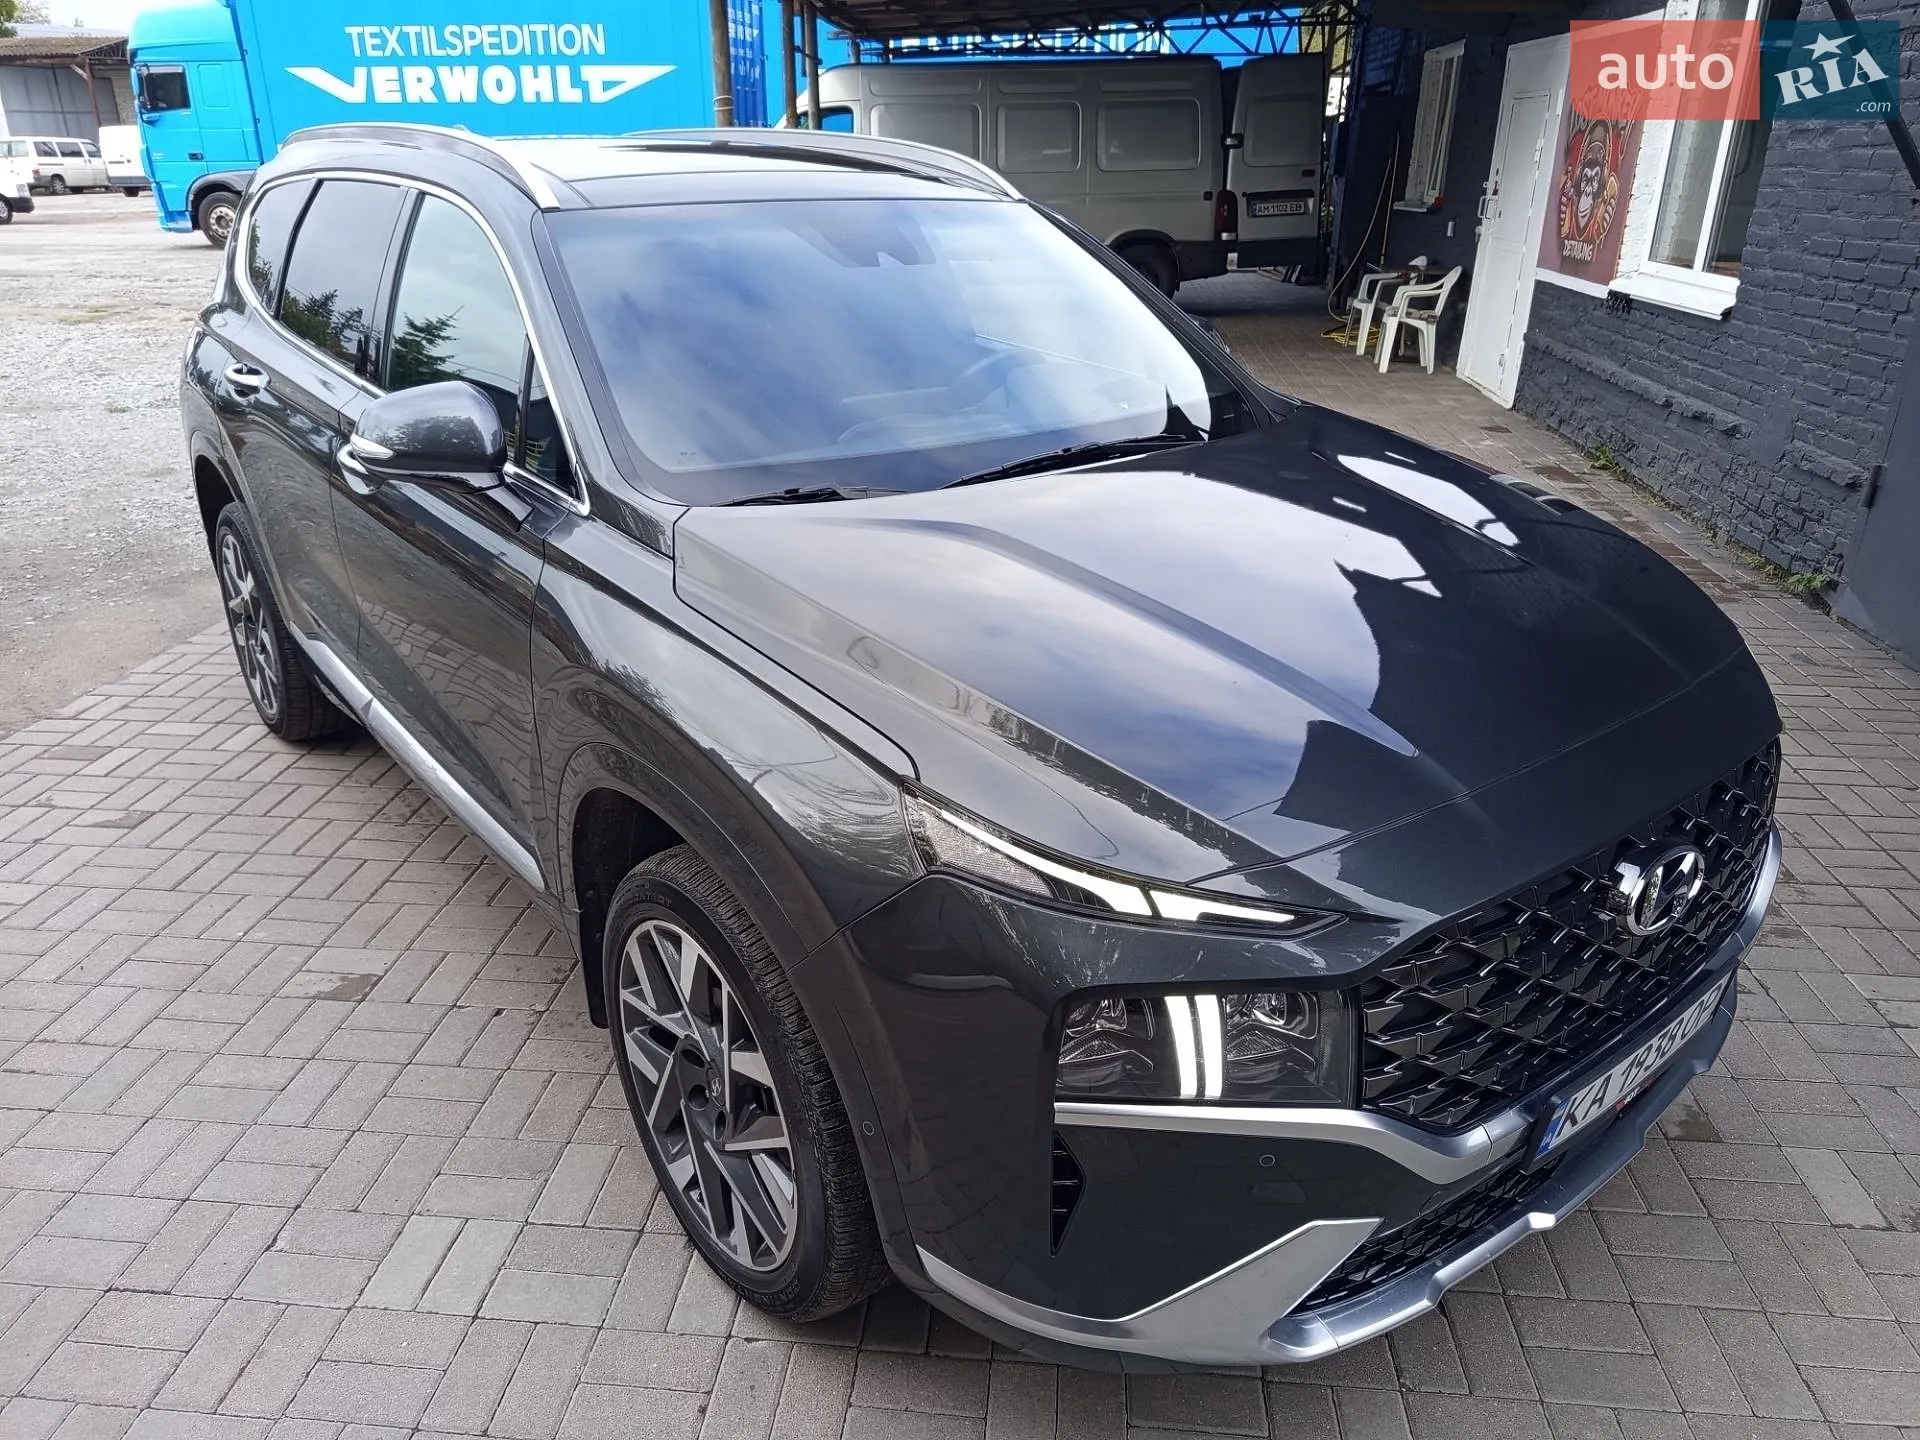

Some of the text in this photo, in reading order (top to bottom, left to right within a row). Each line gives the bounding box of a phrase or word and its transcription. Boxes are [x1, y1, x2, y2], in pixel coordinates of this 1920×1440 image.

[344, 23, 607, 57] TEXTILSPEDITION
[1556, 1073, 1612, 1138] KA
[1619, 1017, 1684, 1093] 1938
